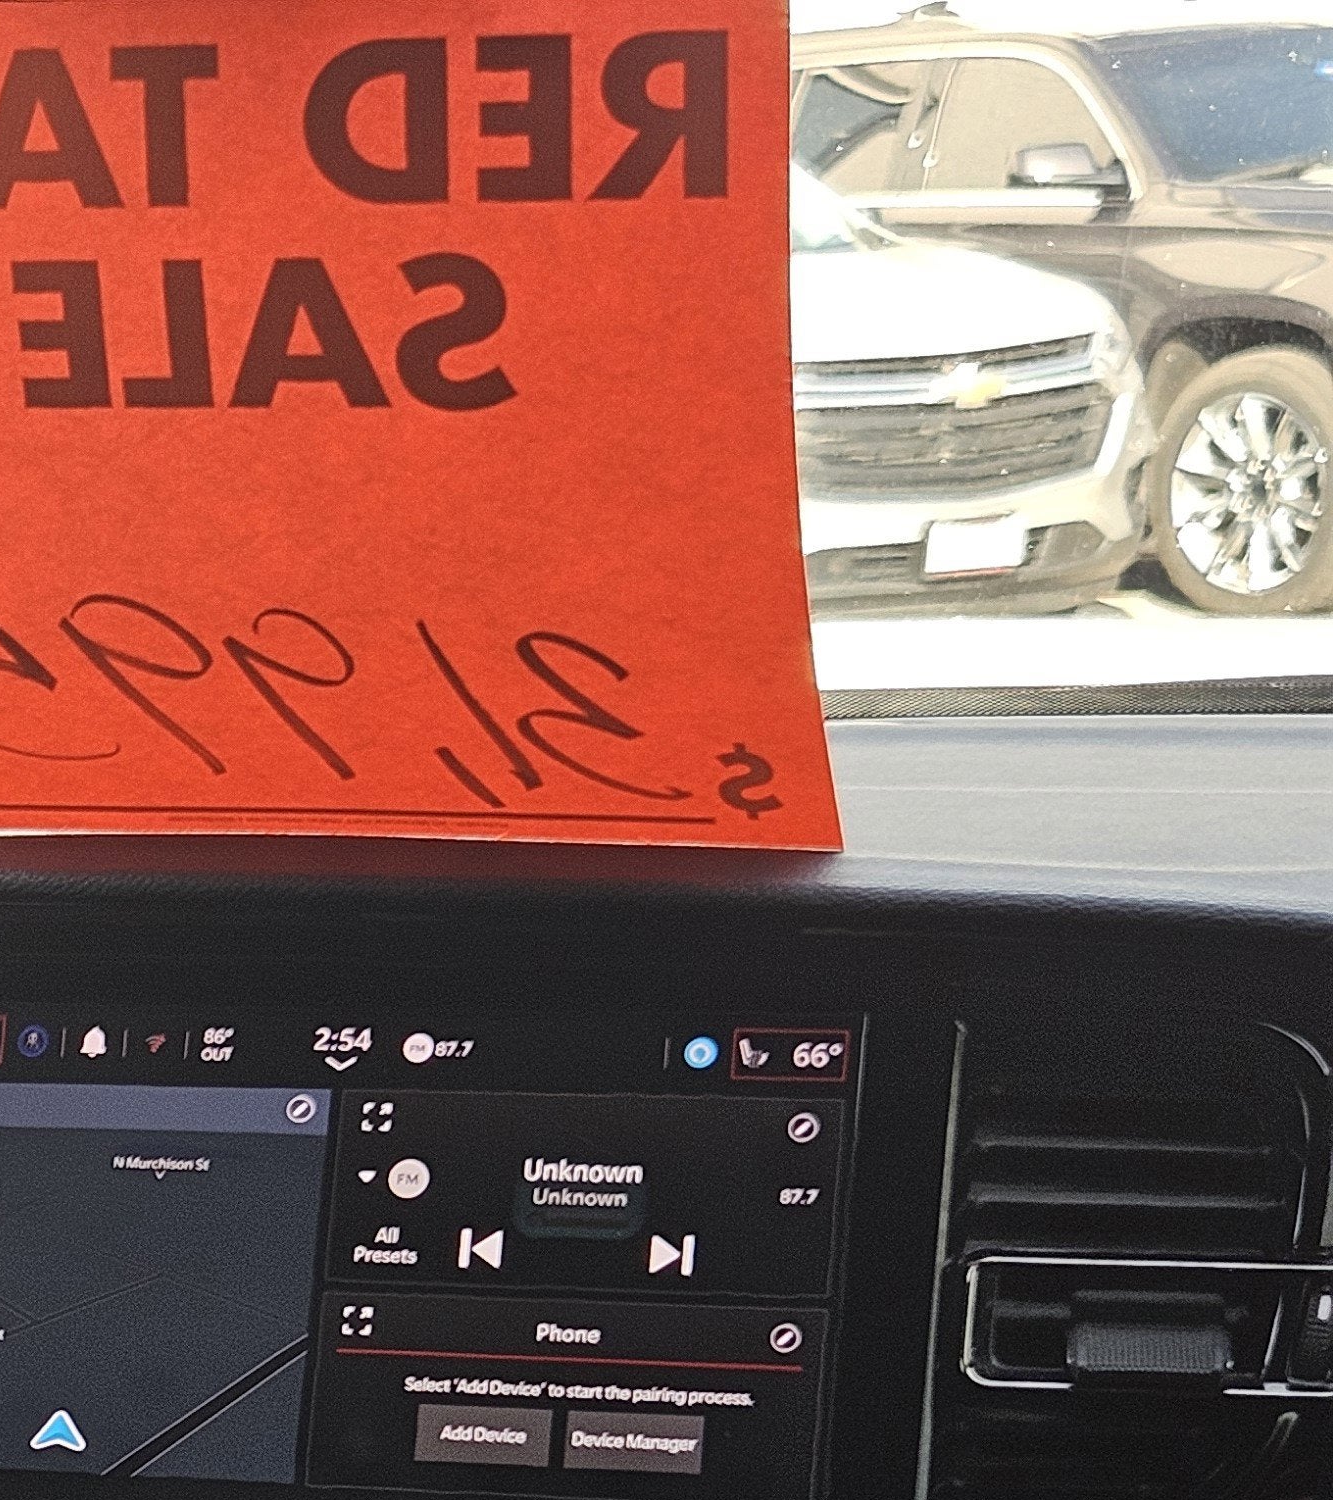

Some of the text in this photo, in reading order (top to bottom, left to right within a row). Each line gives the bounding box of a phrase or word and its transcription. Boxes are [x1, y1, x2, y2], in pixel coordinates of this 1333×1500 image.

[314, 1027, 372, 1051] 2:54
[434, 1040, 475, 1058] 87.7
[201, 1047, 232, 1062] OUT
[113, 1156, 210, 1172] N Murchison St
[523, 1157, 643, 1186] Unknown
[396, 1172, 420, 1185] FM
[532, 1188, 628, 1208] Unknown
[778, 1188, 819, 1206] 87.7
[375, 1226, 400, 1244] All
[353, 1246, 418, 1266] Presets
[535, 1323, 602, 1345] Phone
[404, 1376, 451, 1394] Select
[548, 1383, 565, 1397] to
[566, 1386, 603, 1399] start
[604, 1386, 631, 1401] the
[632, 1388, 686, 1406] pairing
[688, 1391, 754, 1407] process.
[440, 1425, 528, 1445] Add Device
[571, 1430, 699, 1454] Device Manager
